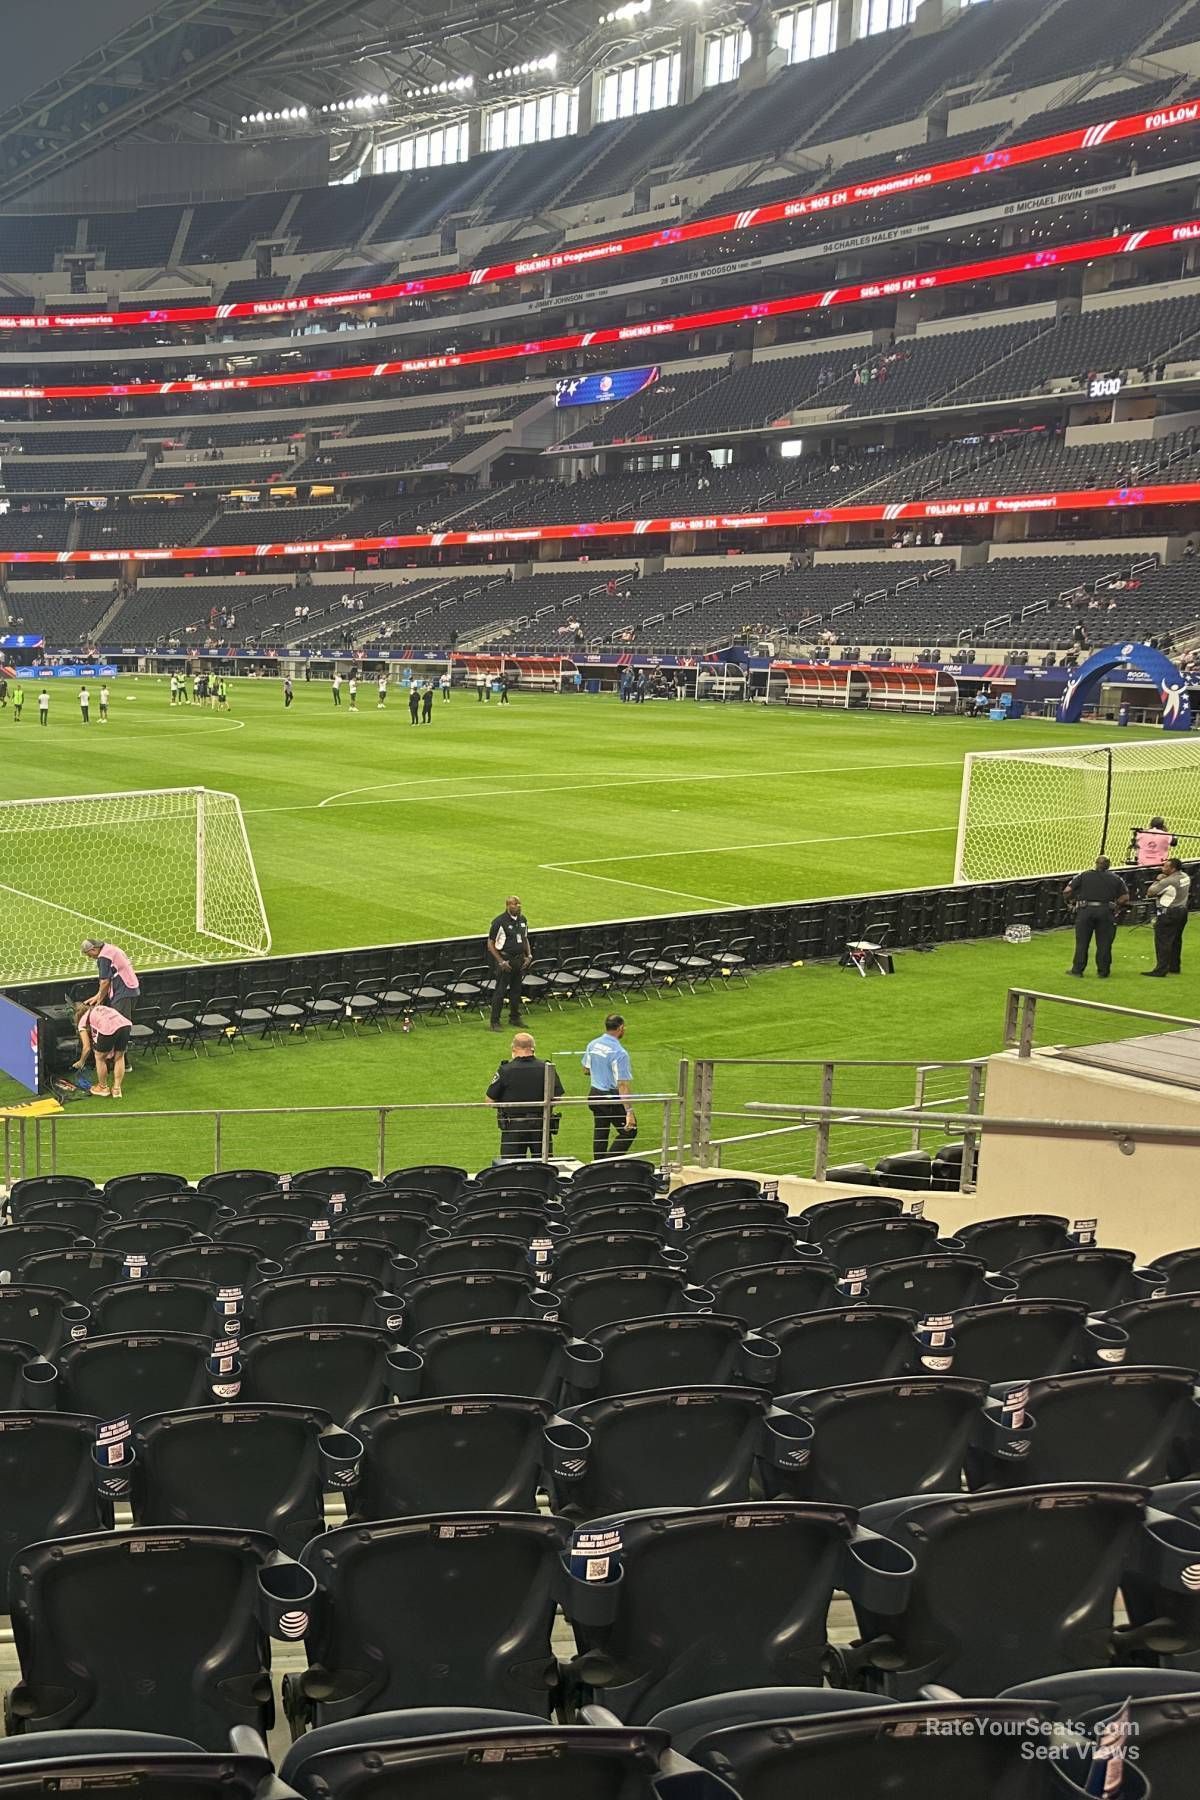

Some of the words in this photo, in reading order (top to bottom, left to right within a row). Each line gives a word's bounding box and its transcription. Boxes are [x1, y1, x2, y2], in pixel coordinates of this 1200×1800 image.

[1145, 104, 1198, 130] FOLLOW
[784, 197, 830, 216] SIGA-NOS
[832, 192, 847, 204] EM
[1016, 197, 1056, 213] MICHAEL
[1058, 190, 1082, 203] IRVIN
[834, 236, 870, 251] CHARLES
[872, 229, 899, 243] HALEY
[1173, 224, 1200, 241] FOLL
[515, 257, 551, 274] SÍGUENOS
[670, 272, 699, 284] DARREN
[700, 264, 737, 277] WOODSON
[554, 294, 583, 306] JOHNSON
[1090, 378, 1120, 398] 30:00
[926, 503, 961, 515] FOLLOW
[963, 502, 975, 513] US
[978, 501, 990, 512] AT
